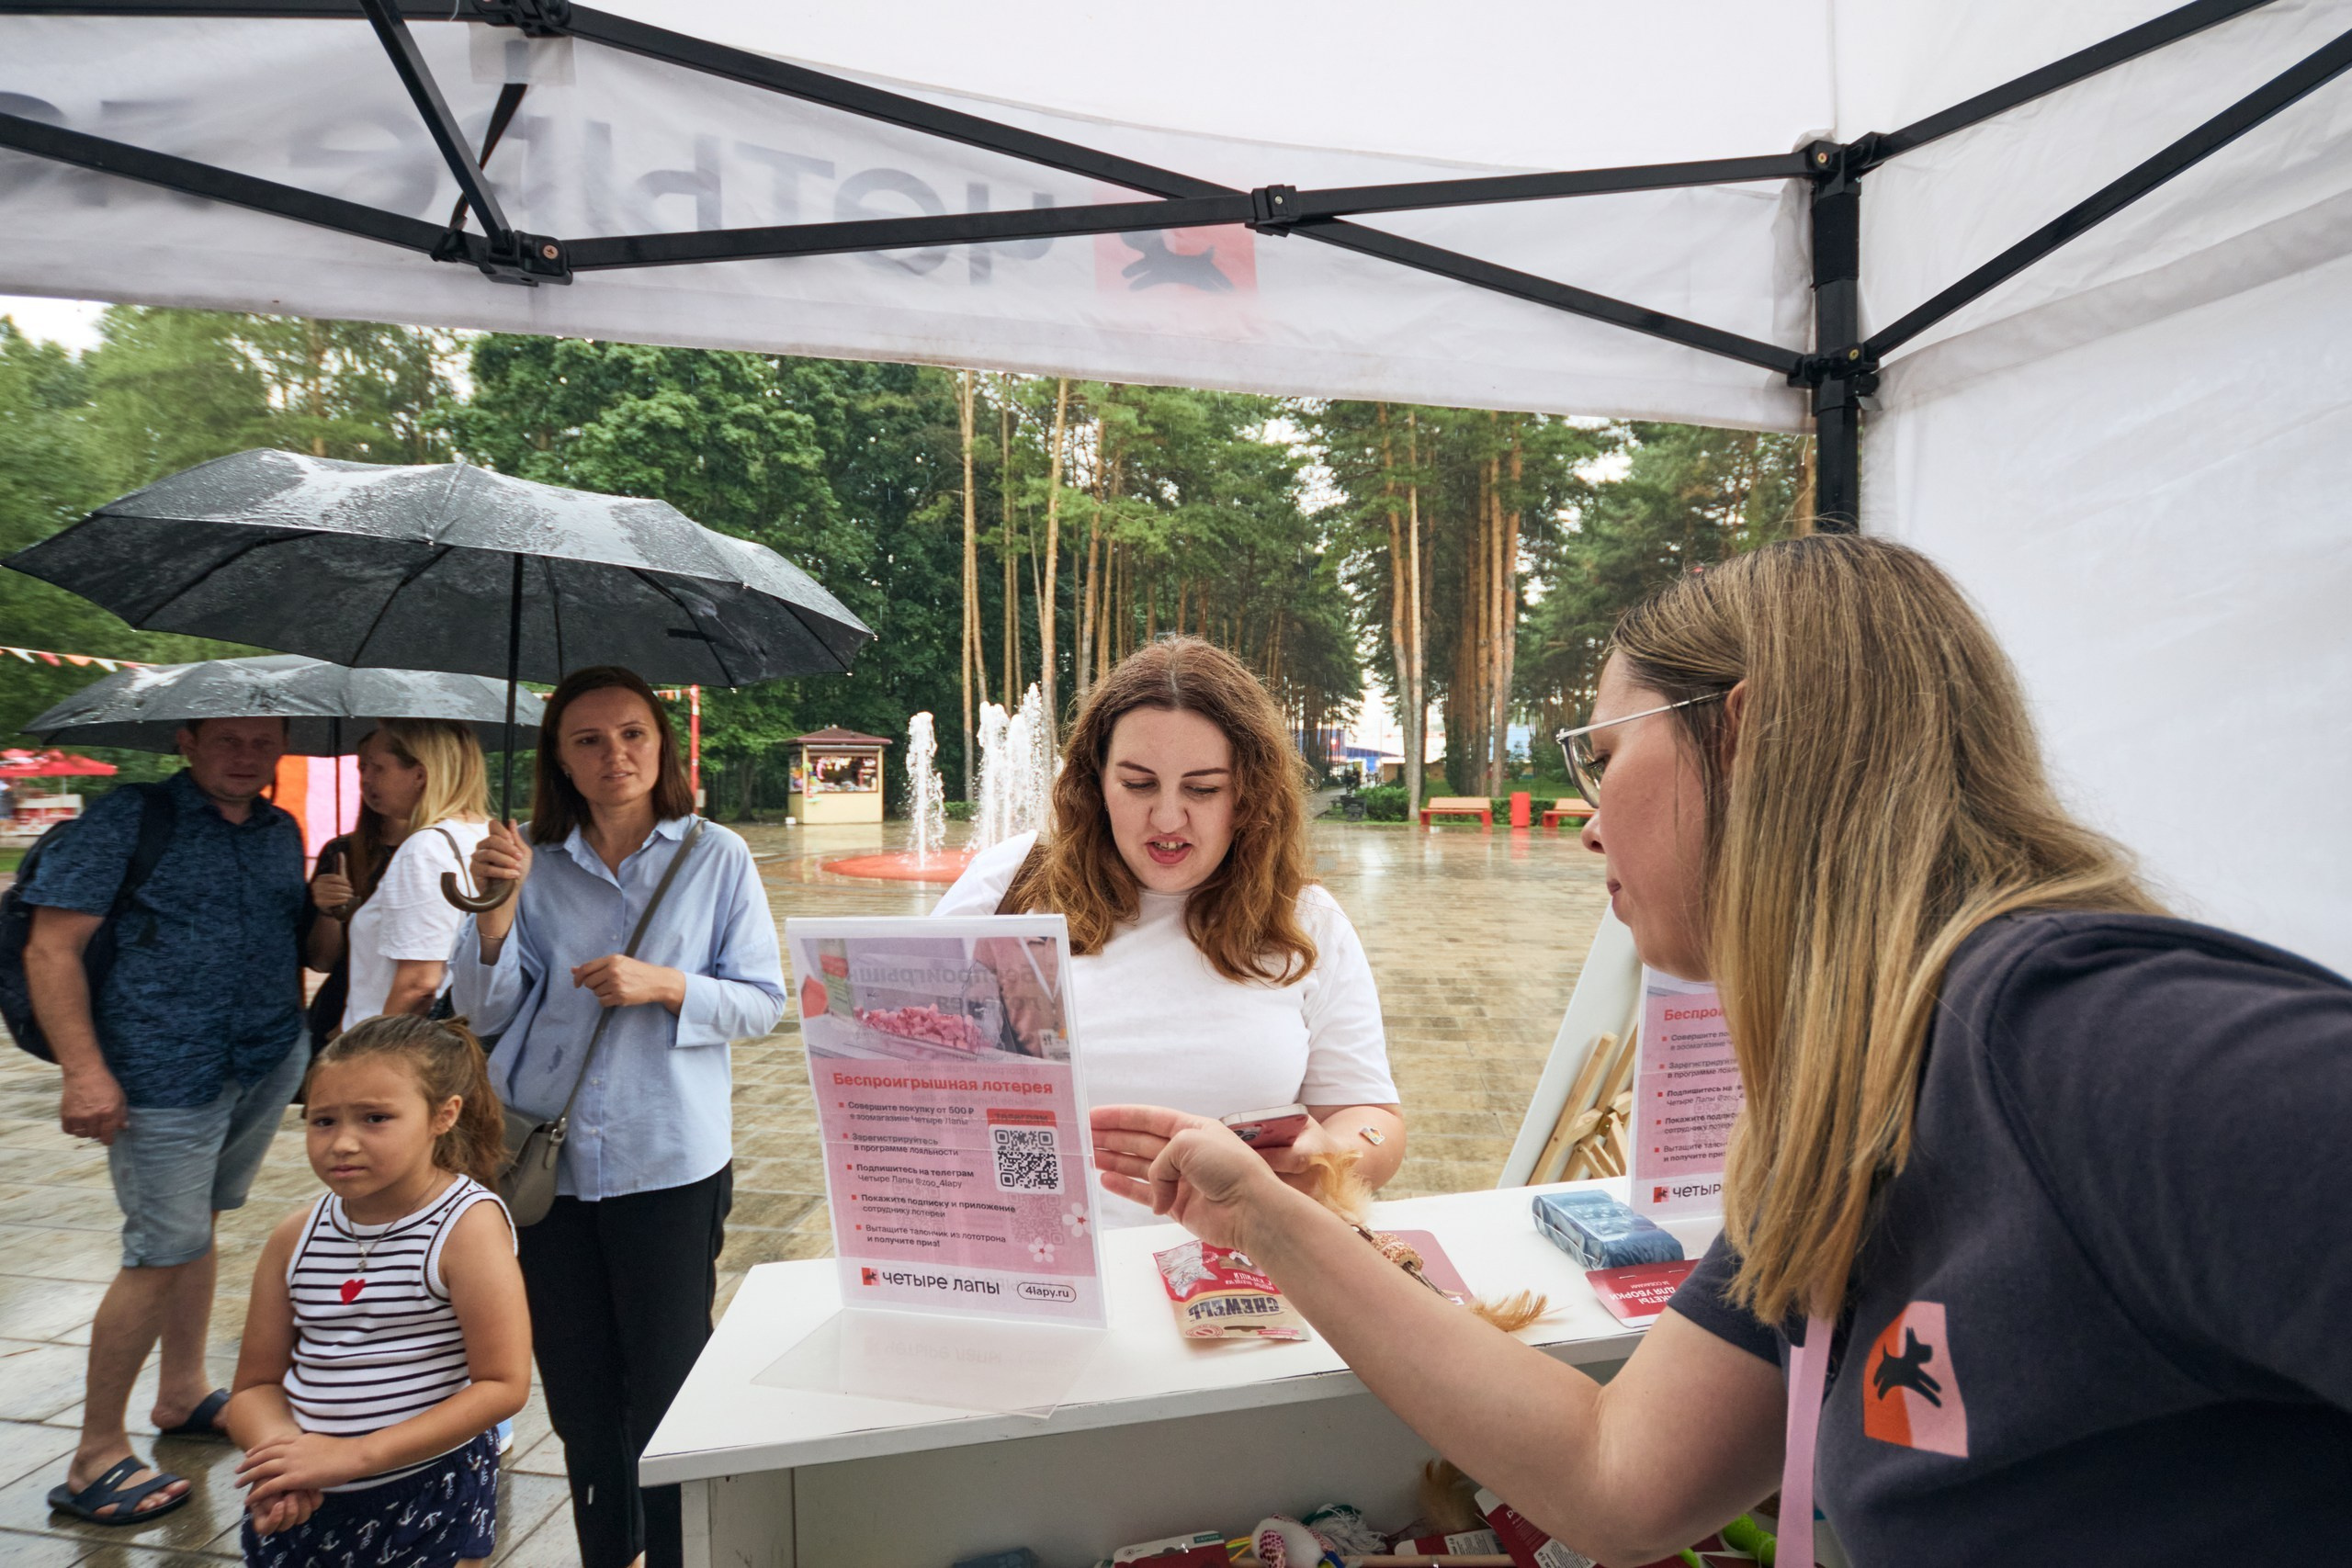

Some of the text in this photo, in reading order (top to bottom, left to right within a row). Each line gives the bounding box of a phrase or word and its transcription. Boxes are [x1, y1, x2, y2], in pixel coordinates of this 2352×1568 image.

[1671, 1032, 1717, 1041] Совершите
[1677, 1041, 1725, 1050] зоомагазине
[1674, 1069, 1716, 1079] программе
[833, 1073, 1054, 1095] Беспроигрышная лотерея
[1667, 1086, 1721, 1097] Подпишитесь
[848, 1101, 898, 1112] Совершите
[899, 1104, 934, 1114] покупку
[948, 1106, 967, 1114] 500
[856, 1114, 910, 1122] зоомагазине
[910, 1115, 943, 1125] Четыре
[1665, 1114, 1705, 1124] Покажите
[852, 1133, 938, 1145] Зарегистрируйтесь
[860, 1145, 908, 1154] программе
[910, 1147, 959, 1156] лояльности
[1664, 1143, 1702, 1152] Вытащите
[1670, 1153, 1707, 1161] получите
[856, 1164, 918, 1175] Подпишитесь
[931, 1168, 975, 1179] телеграм
[858, 1175, 890, 1185] Четыре
[892, 1176, 914, 1186] Лапы
[1672, 1184, 1722, 1198] четыр
[861, 1194, 906, 1203] Покажите
[907, 1198, 949, 1209] подписку
[958, 1201, 1016, 1213] приложение
[863, 1205, 945, 1218] сотруднику лотереи
[866, 1224, 909, 1235] Вытащите
[910, 1227, 948, 1237] талончик
[962, 1233, 1006, 1243] лототрона
[874, 1237, 914, 1247] получите
[882, 1270, 1001, 1295] четыре лапы
[1025, 1287, 1069, 1299] 4lapy.ru
[1609, 1286, 1676, 1301] ДЛЯ УБОРКИ
[1188, 1297, 1279, 1319] CHEWELL
